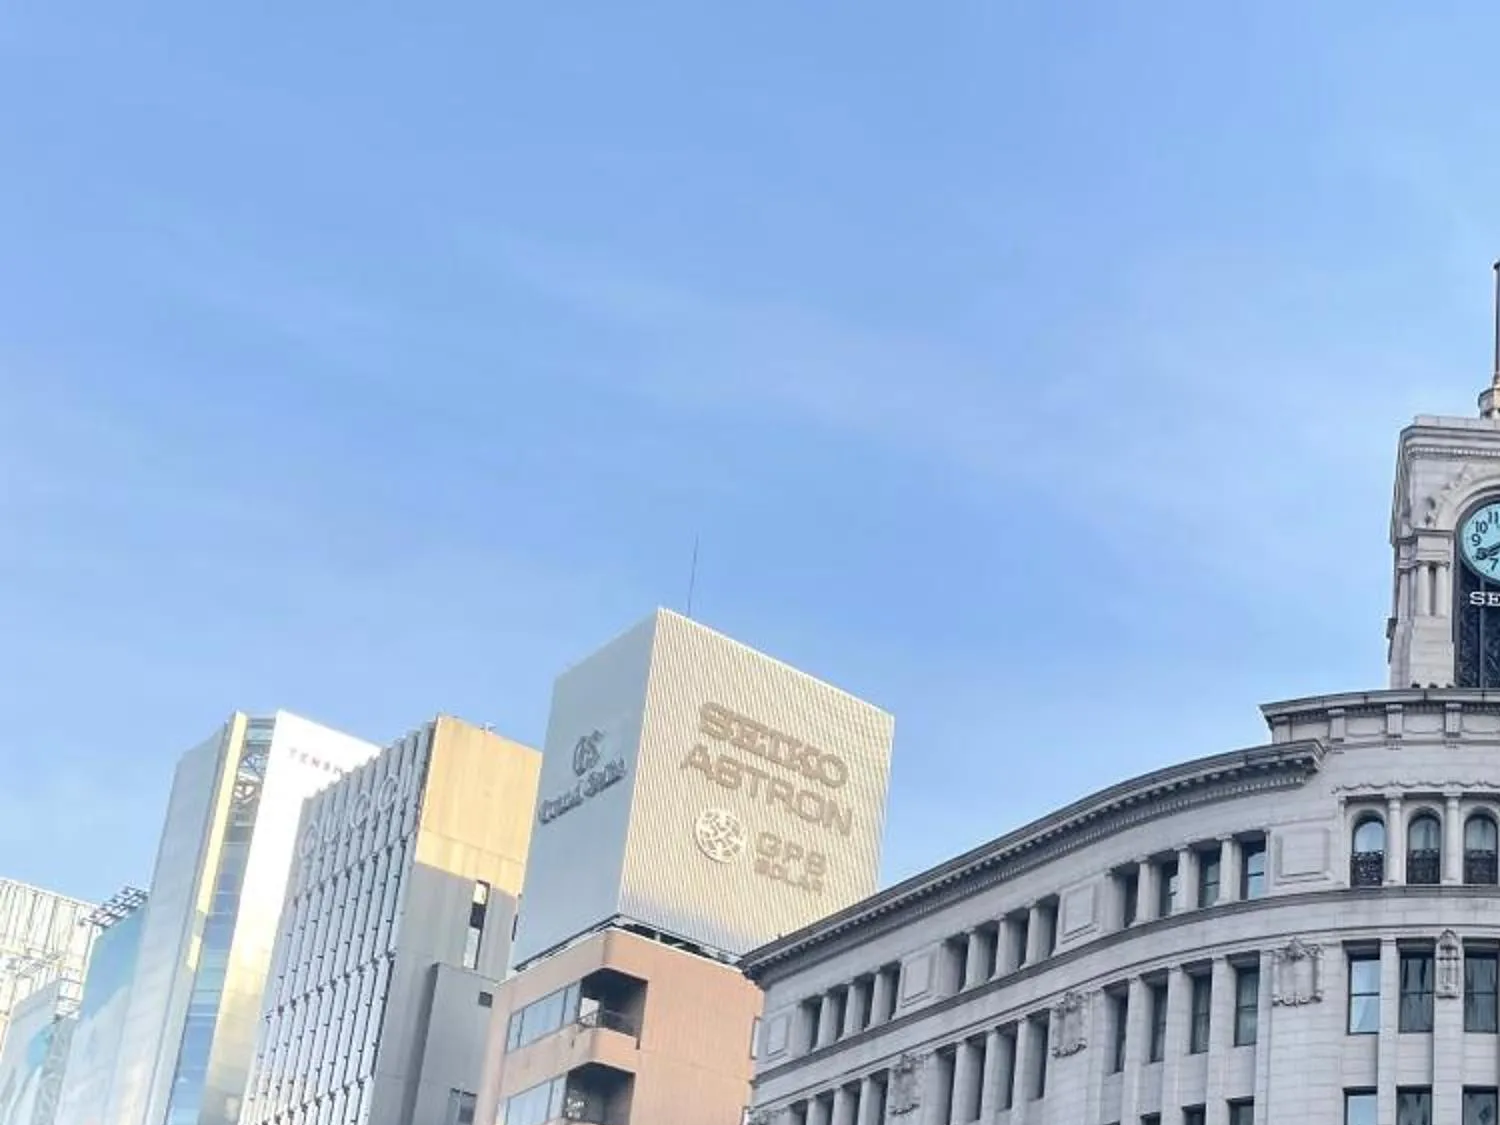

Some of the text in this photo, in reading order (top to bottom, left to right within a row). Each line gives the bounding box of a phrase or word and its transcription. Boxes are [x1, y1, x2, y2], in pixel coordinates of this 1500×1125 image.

[1488, 511, 1499, 524] 11
[1475, 520, 1488, 534] 10
[1471, 533, 1481, 547] 9
[1489, 557, 1499, 571] 7
[700, 701, 850, 789] SEIKO
[680, 744, 853, 837] ASTRON
[756, 831, 827, 877] GPS
